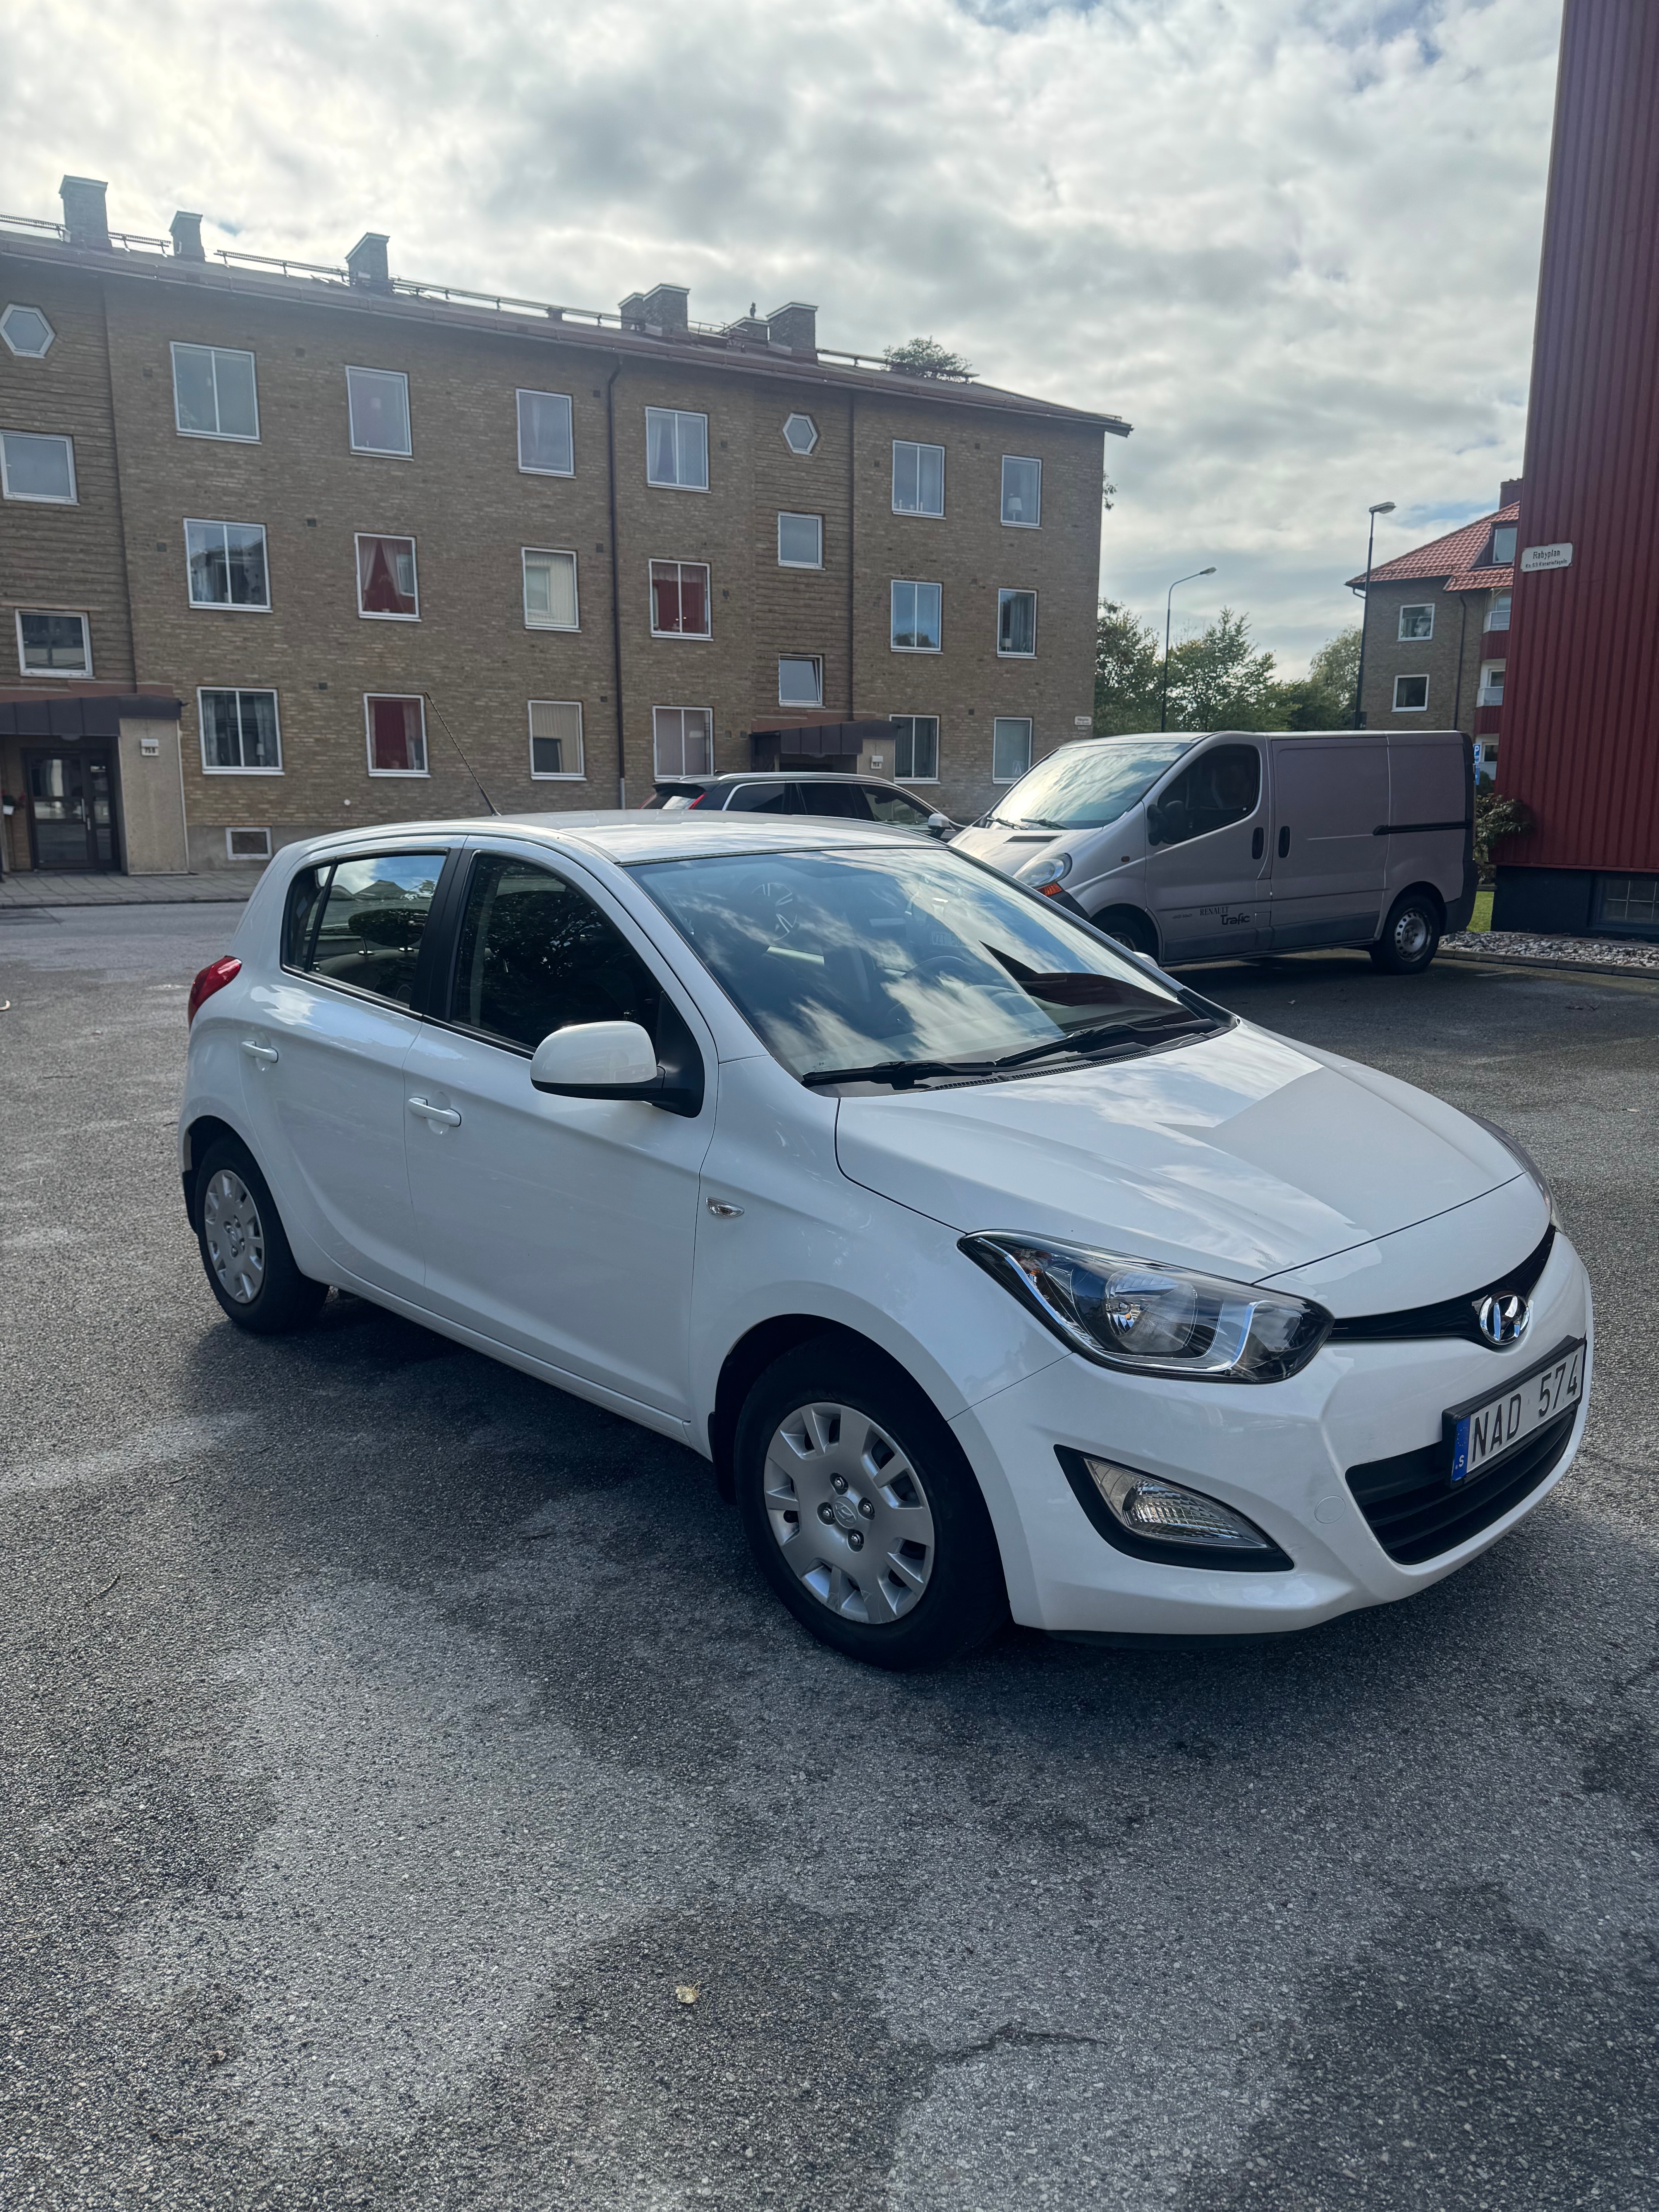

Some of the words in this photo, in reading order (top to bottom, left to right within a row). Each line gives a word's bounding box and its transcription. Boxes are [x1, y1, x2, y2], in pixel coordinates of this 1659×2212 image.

[1474, 745, 1479, 756] P
[1200, 907, 1229, 915] RENAULT
[1221, 913, 1250, 925] Trafic
[1472, 1393, 1522, 1463] NAD
[1539, 1354, 1578, 1417] 574
[1458, 1455, 1465, 1468] S
